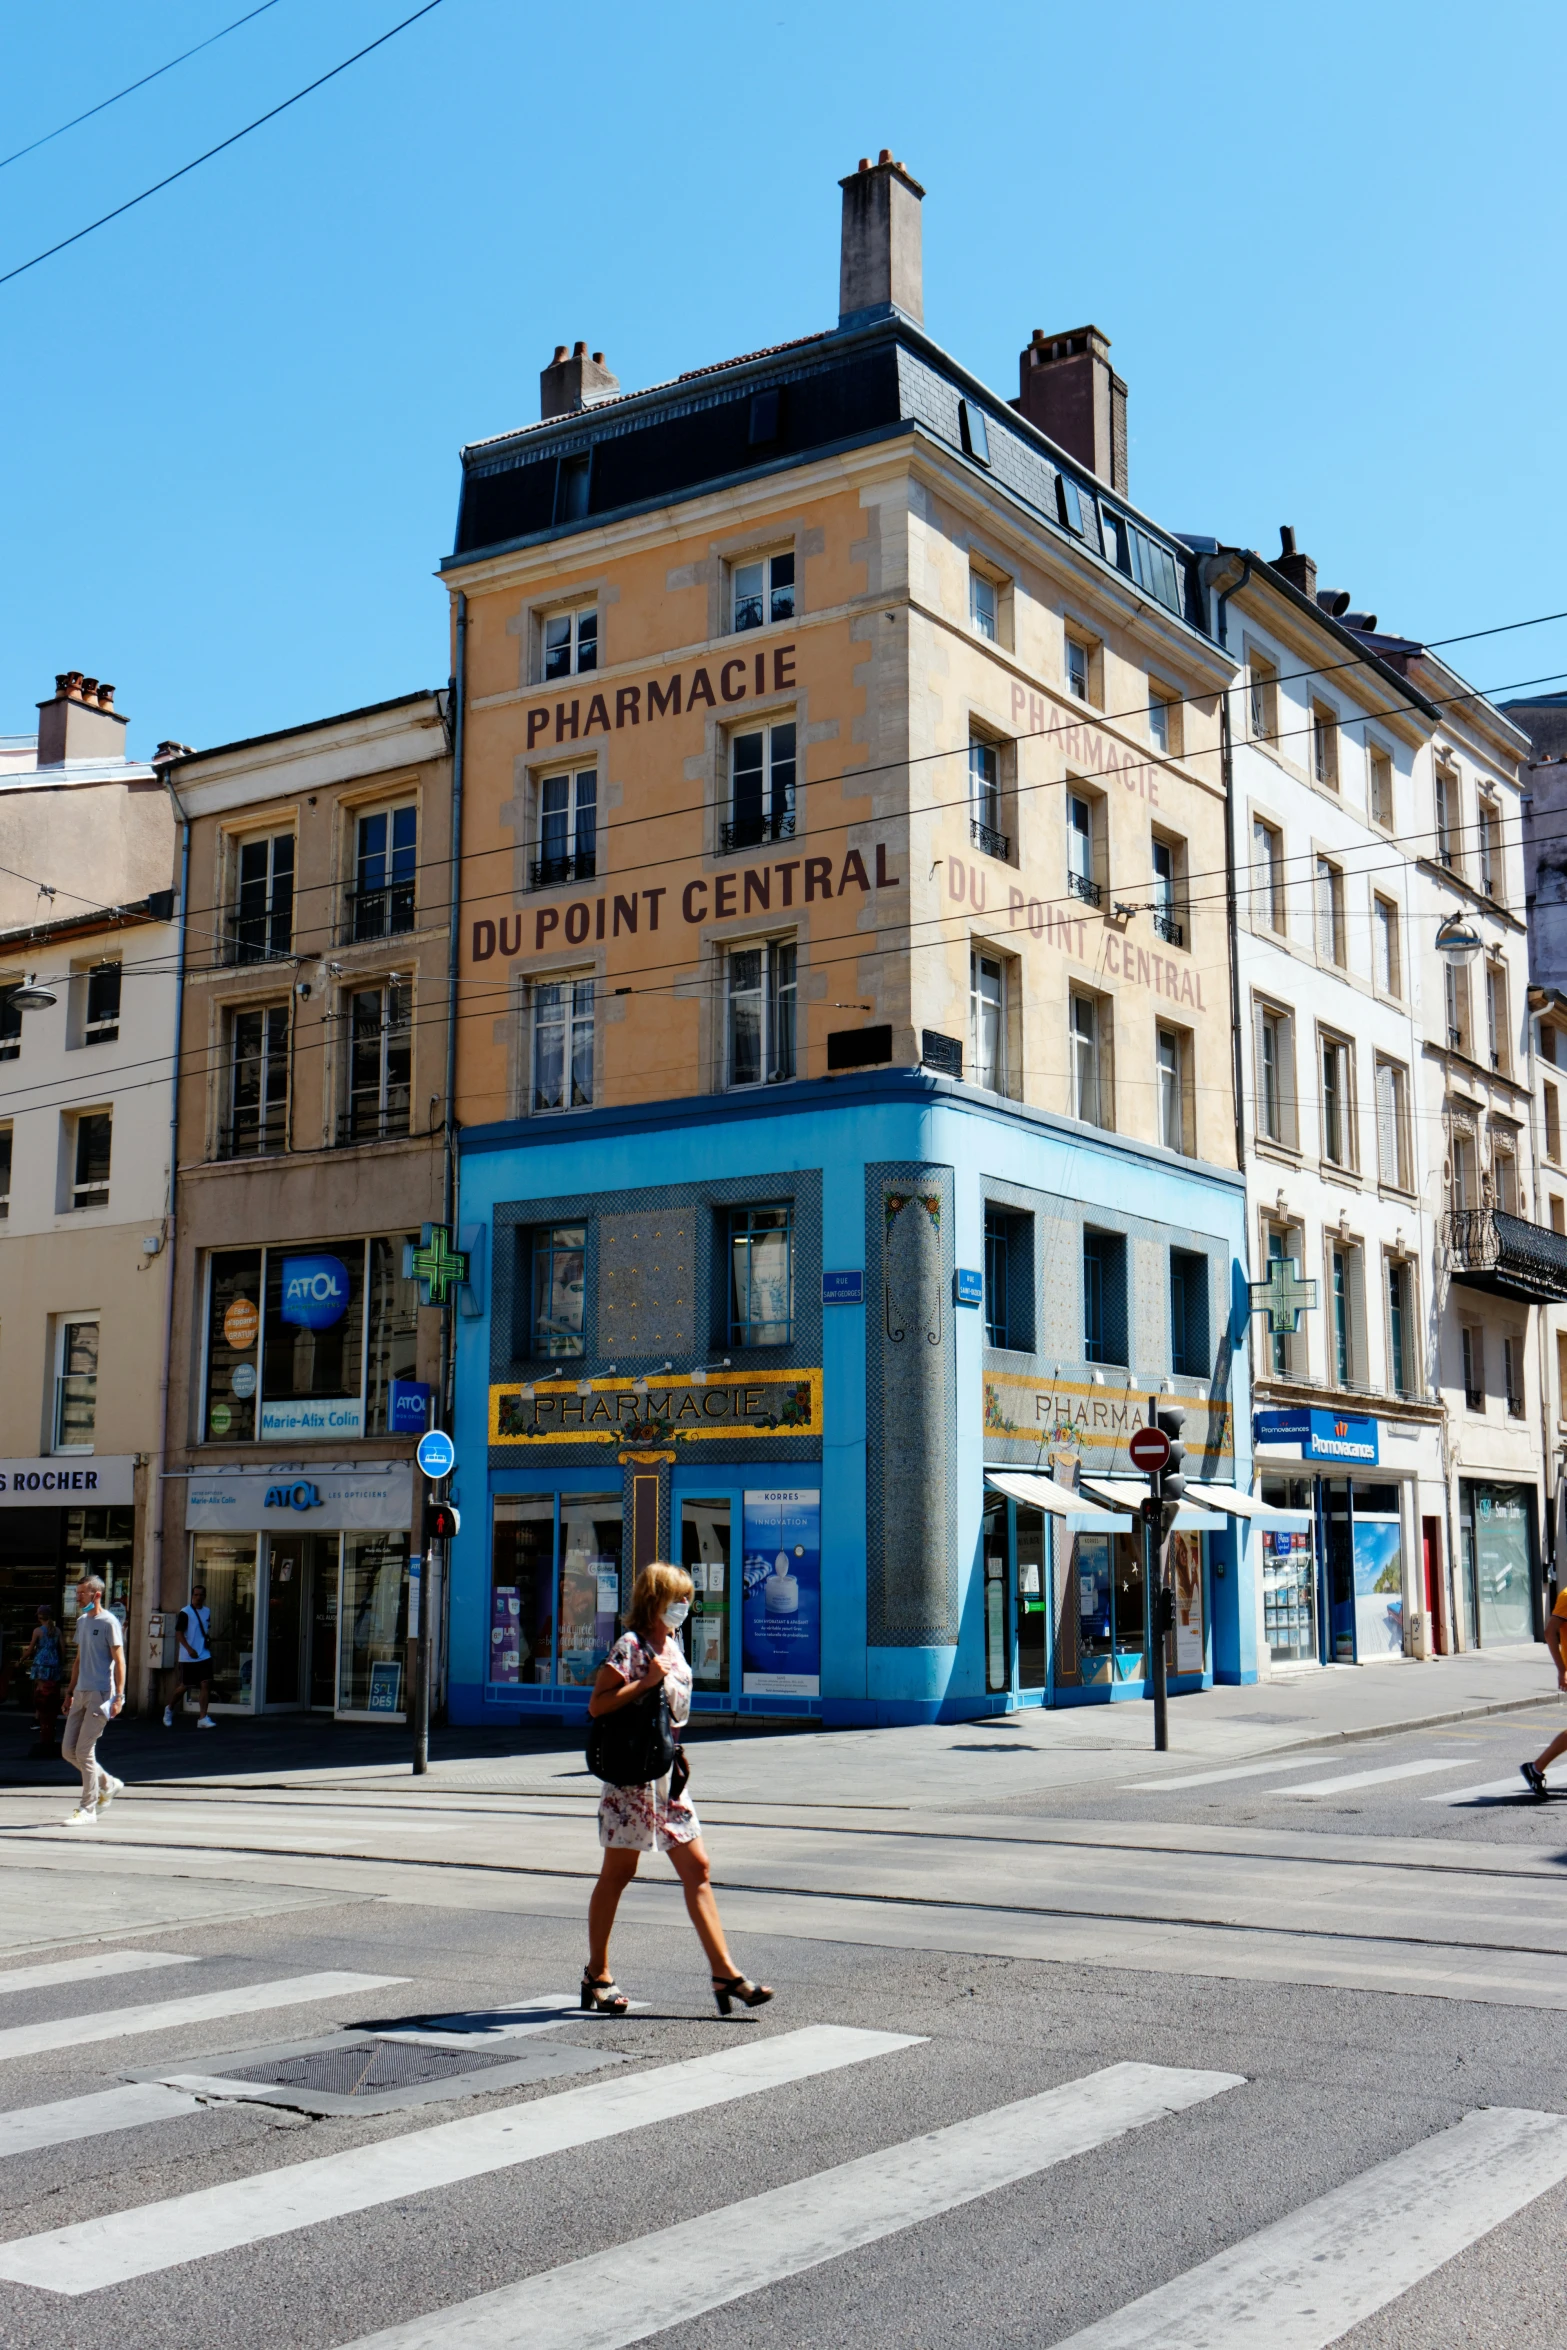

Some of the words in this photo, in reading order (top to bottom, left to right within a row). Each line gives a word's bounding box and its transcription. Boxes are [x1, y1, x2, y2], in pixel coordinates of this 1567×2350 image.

[527, 644, 796, 750] PHARMACIE
[1011, 681, 1159, 806] PHARMACIE
[472, 914, 522, 962] DU
[535, 888, 666, 950] POINT
[682, 843, 900, 924] CENTRAL
[948, 854, 986, 912] DU
[1008, 885, 1087, 959] POINT
[1106, 933, 1206, 1012] CENTRAL
[286, 1272, 342, 1301] ATOL
[836, 1277, 848, 1285] RUE
[966, 1274, 975, 1283] RUE
[234, 1307, 250, 1315] Essai
[228, 1329, 256, 1340] GRATUIT
[534, 1388, 771, 1425] PHARMACIE
[1036, 1395, 1145, 1430] PHARMA
[263, 1413, 325, 1429] Marie-Alix
[329, 1411, 359, 1427] Colin
[1261, 1425, 1310, 1434] Promovacances
[1312, 1433, 1375, 1459] Promovacances
[14, 1472, 98, 1491] ROCHER
[191, 1496, 220, 1504] Marie-Alix
[221, 1496, 237, 1504] Colin
[264, 1480, 323, 1511] ATOL
[764, 1493, 799, 1501] KORRES
[755, 1518, 808, 1526] INNOVATION
[371, 1695, 393, 1707] DES
